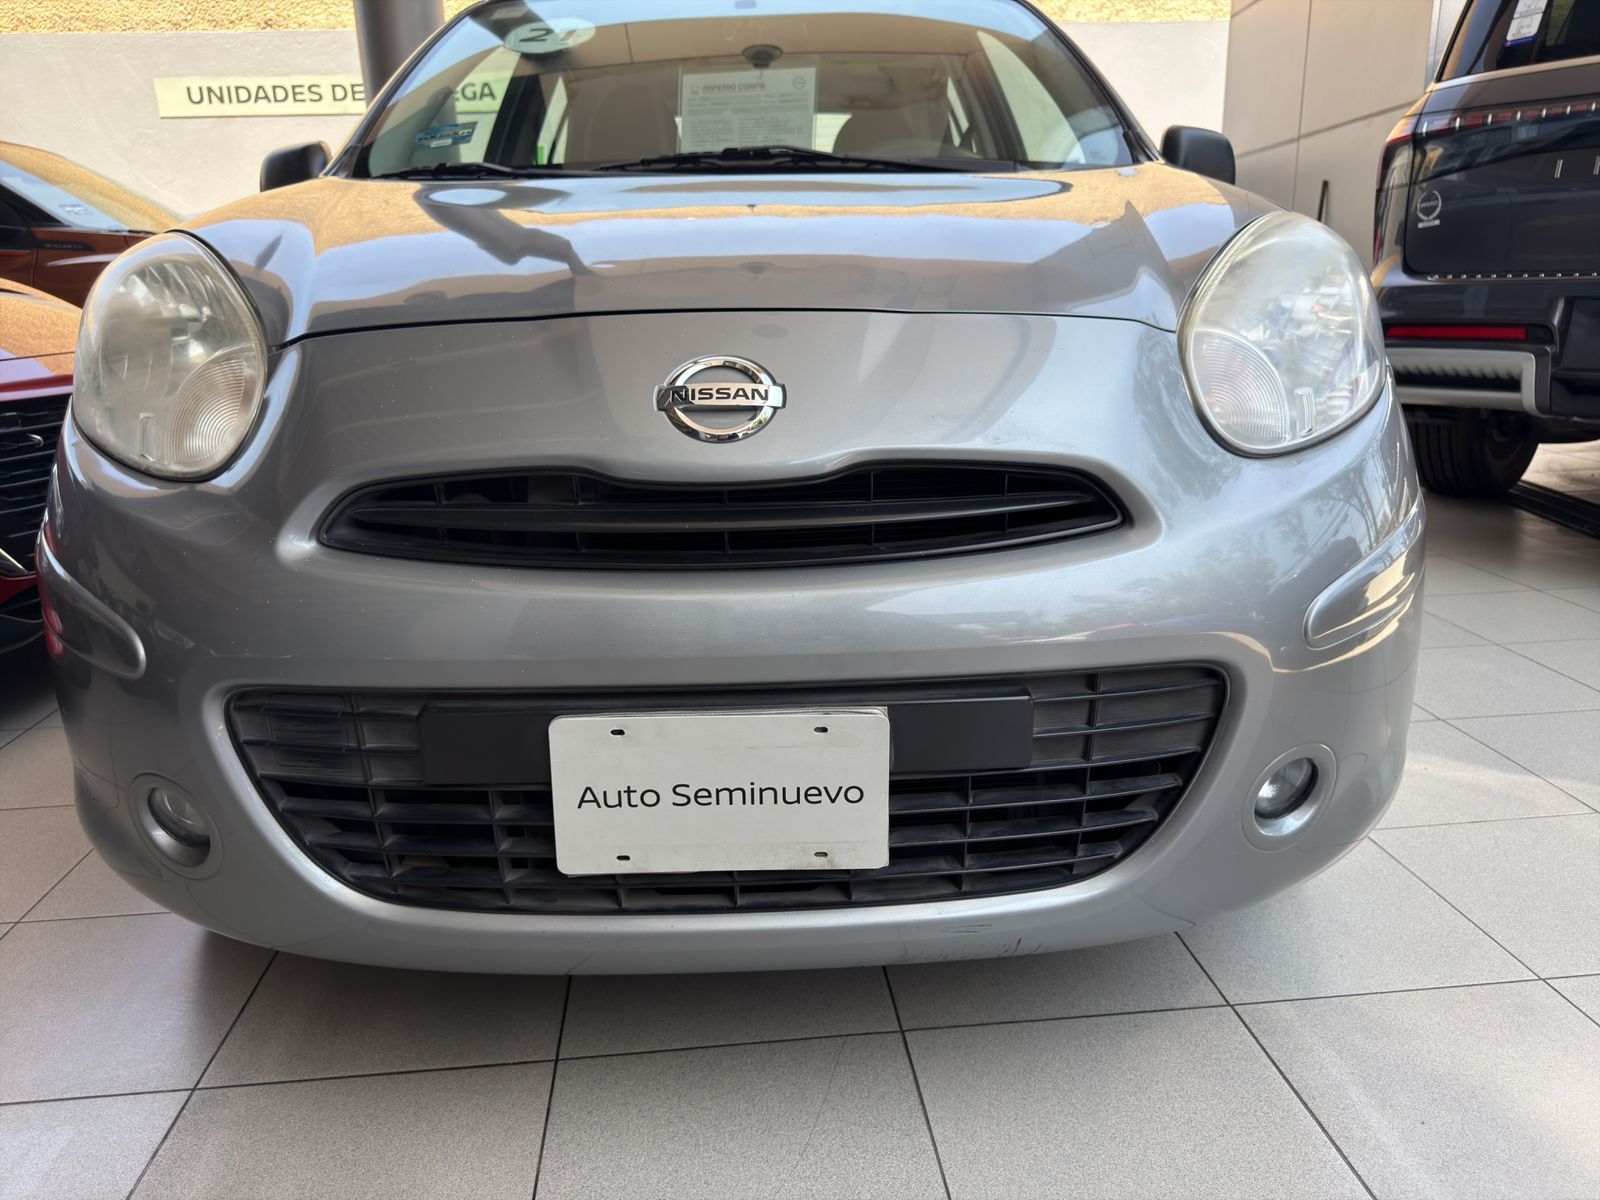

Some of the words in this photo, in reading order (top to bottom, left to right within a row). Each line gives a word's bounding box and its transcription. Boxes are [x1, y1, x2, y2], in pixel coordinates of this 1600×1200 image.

[186, 84, 323, 105] UNIDADES
[331, 83, 366, 102] DE
[671, 387, 768, 401] NISSAN
[577, 785, 661, 809] Auto
[671, 781, 865, 807] Seminuevo
